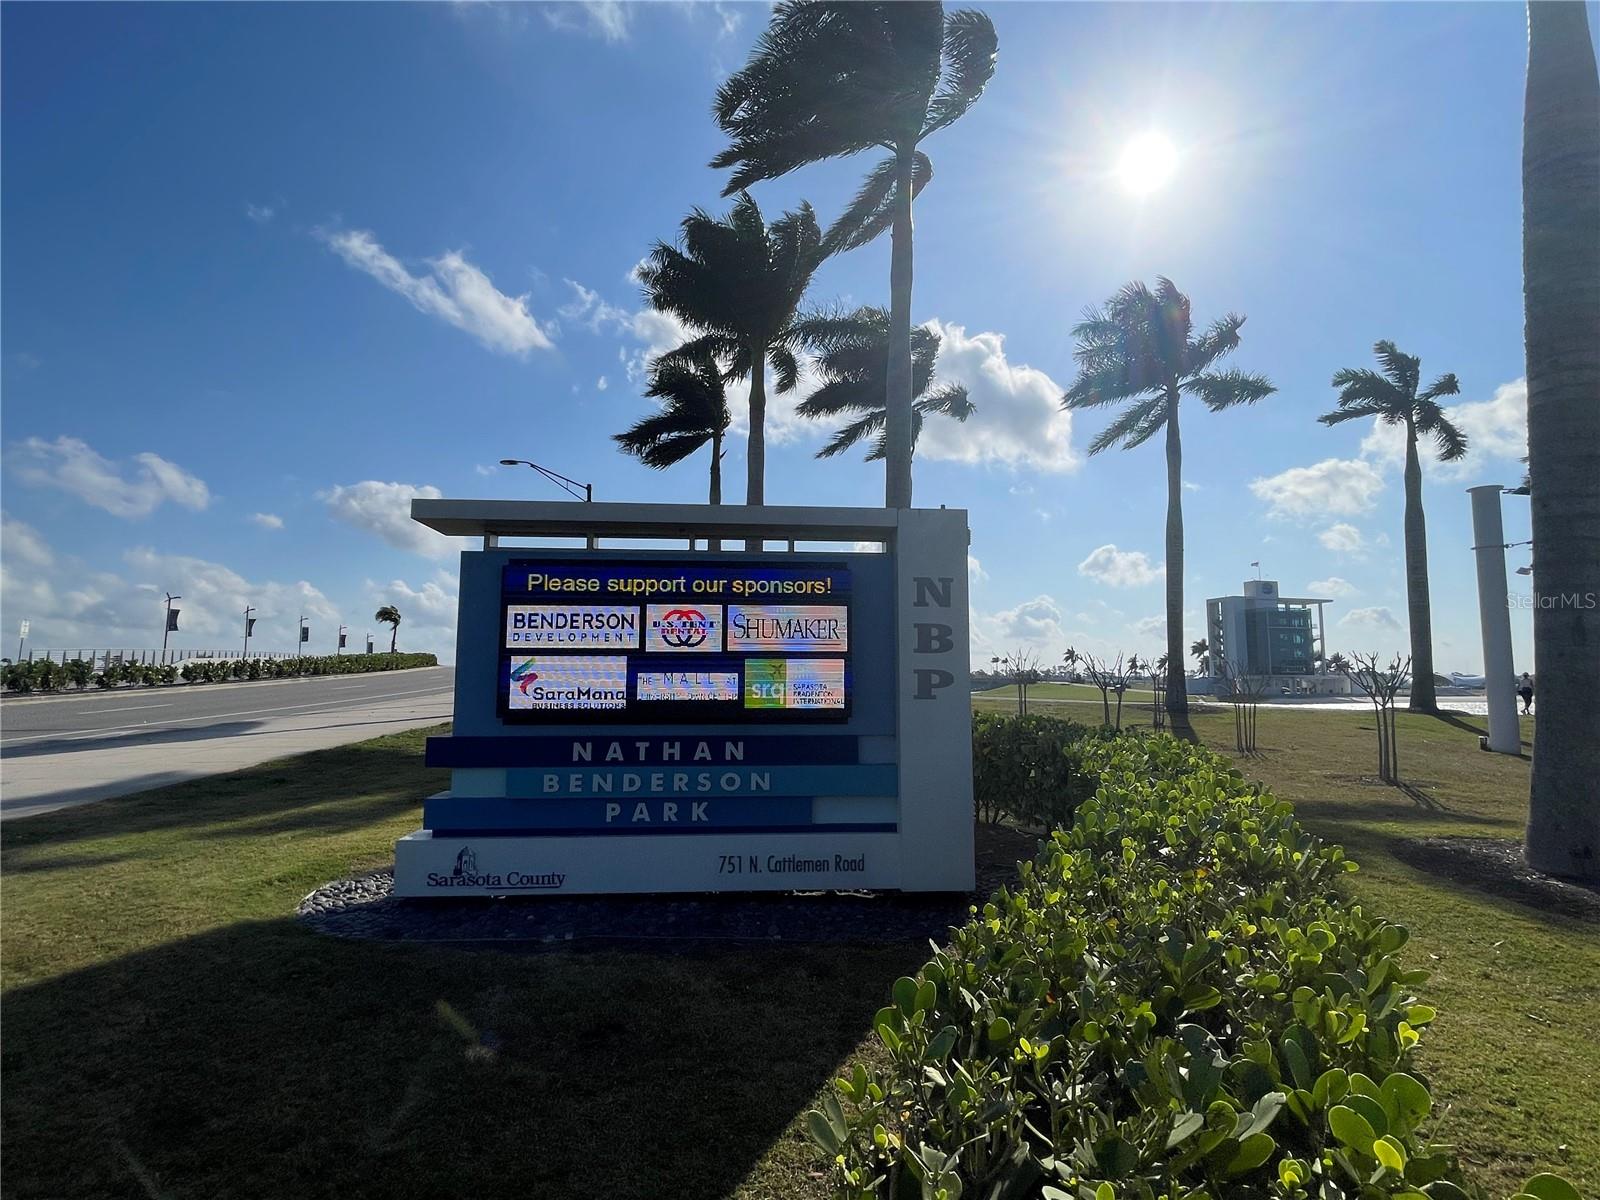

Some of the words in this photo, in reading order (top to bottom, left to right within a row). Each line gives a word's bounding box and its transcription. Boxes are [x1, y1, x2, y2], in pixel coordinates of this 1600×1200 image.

[527, 573, 600, 592] Please
[607, 576, 686, 596] support
[692, 579, 727, 593] our
[732, 577, 832, 597] sponsors!
[513, 612, 635, 630] BENDERSON
[681, 620, 717, 628] TENT
[732, 613, 841, 640] SHUMAKER
[512, 632, 635, 643] DEVELOPMENT
[532, 686, 627, 701] SaraMana
[751, 683, 785, 705] srq
[572, 741, 745, 762] NATHAN
[543, 772, 771, 793] BENDERSON
[605, 801, 709, 823] PARK
[719, 855, 743, 874] 751
[750, 855, 763, 873] N.
[767, 854, 830, 873] Cattlemen
[834, 853, 865, 872] Road
[426, 872, 501, 888] Sarasota
[506, 871, 567, 888] County
